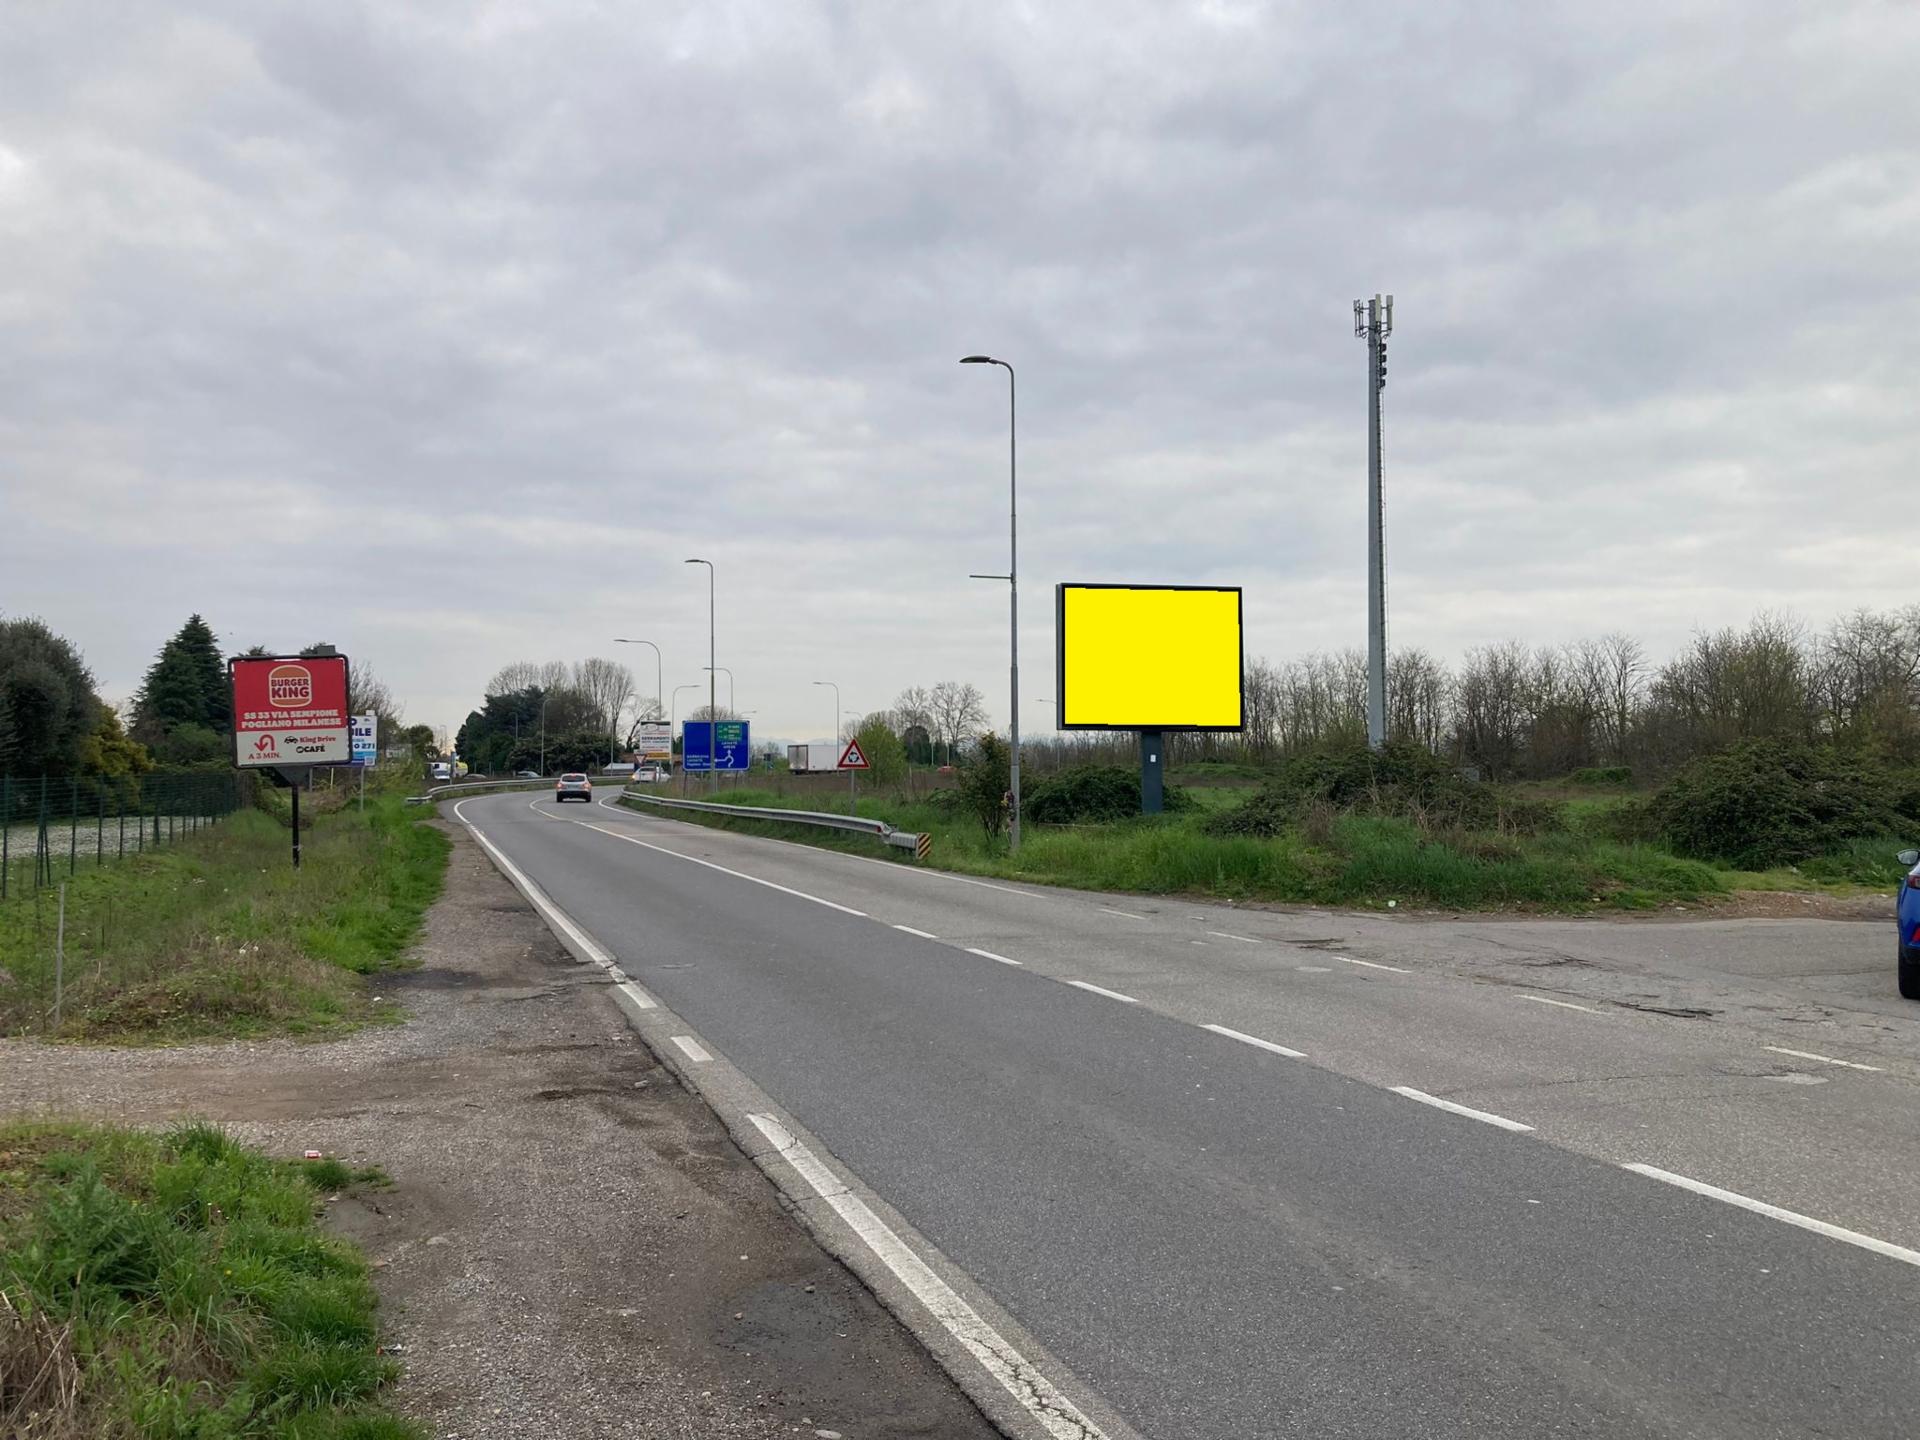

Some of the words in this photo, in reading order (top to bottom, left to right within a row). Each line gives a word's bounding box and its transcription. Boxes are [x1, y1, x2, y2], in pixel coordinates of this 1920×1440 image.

[271, 678, 309, 688] BURGER
[271, 687, 310, 699] KING
[290, 709, 338, 717] SEMPIONE
[241, 720, 291, 728] POGLIANO
[293, 718, 341, 726] MILANESE
